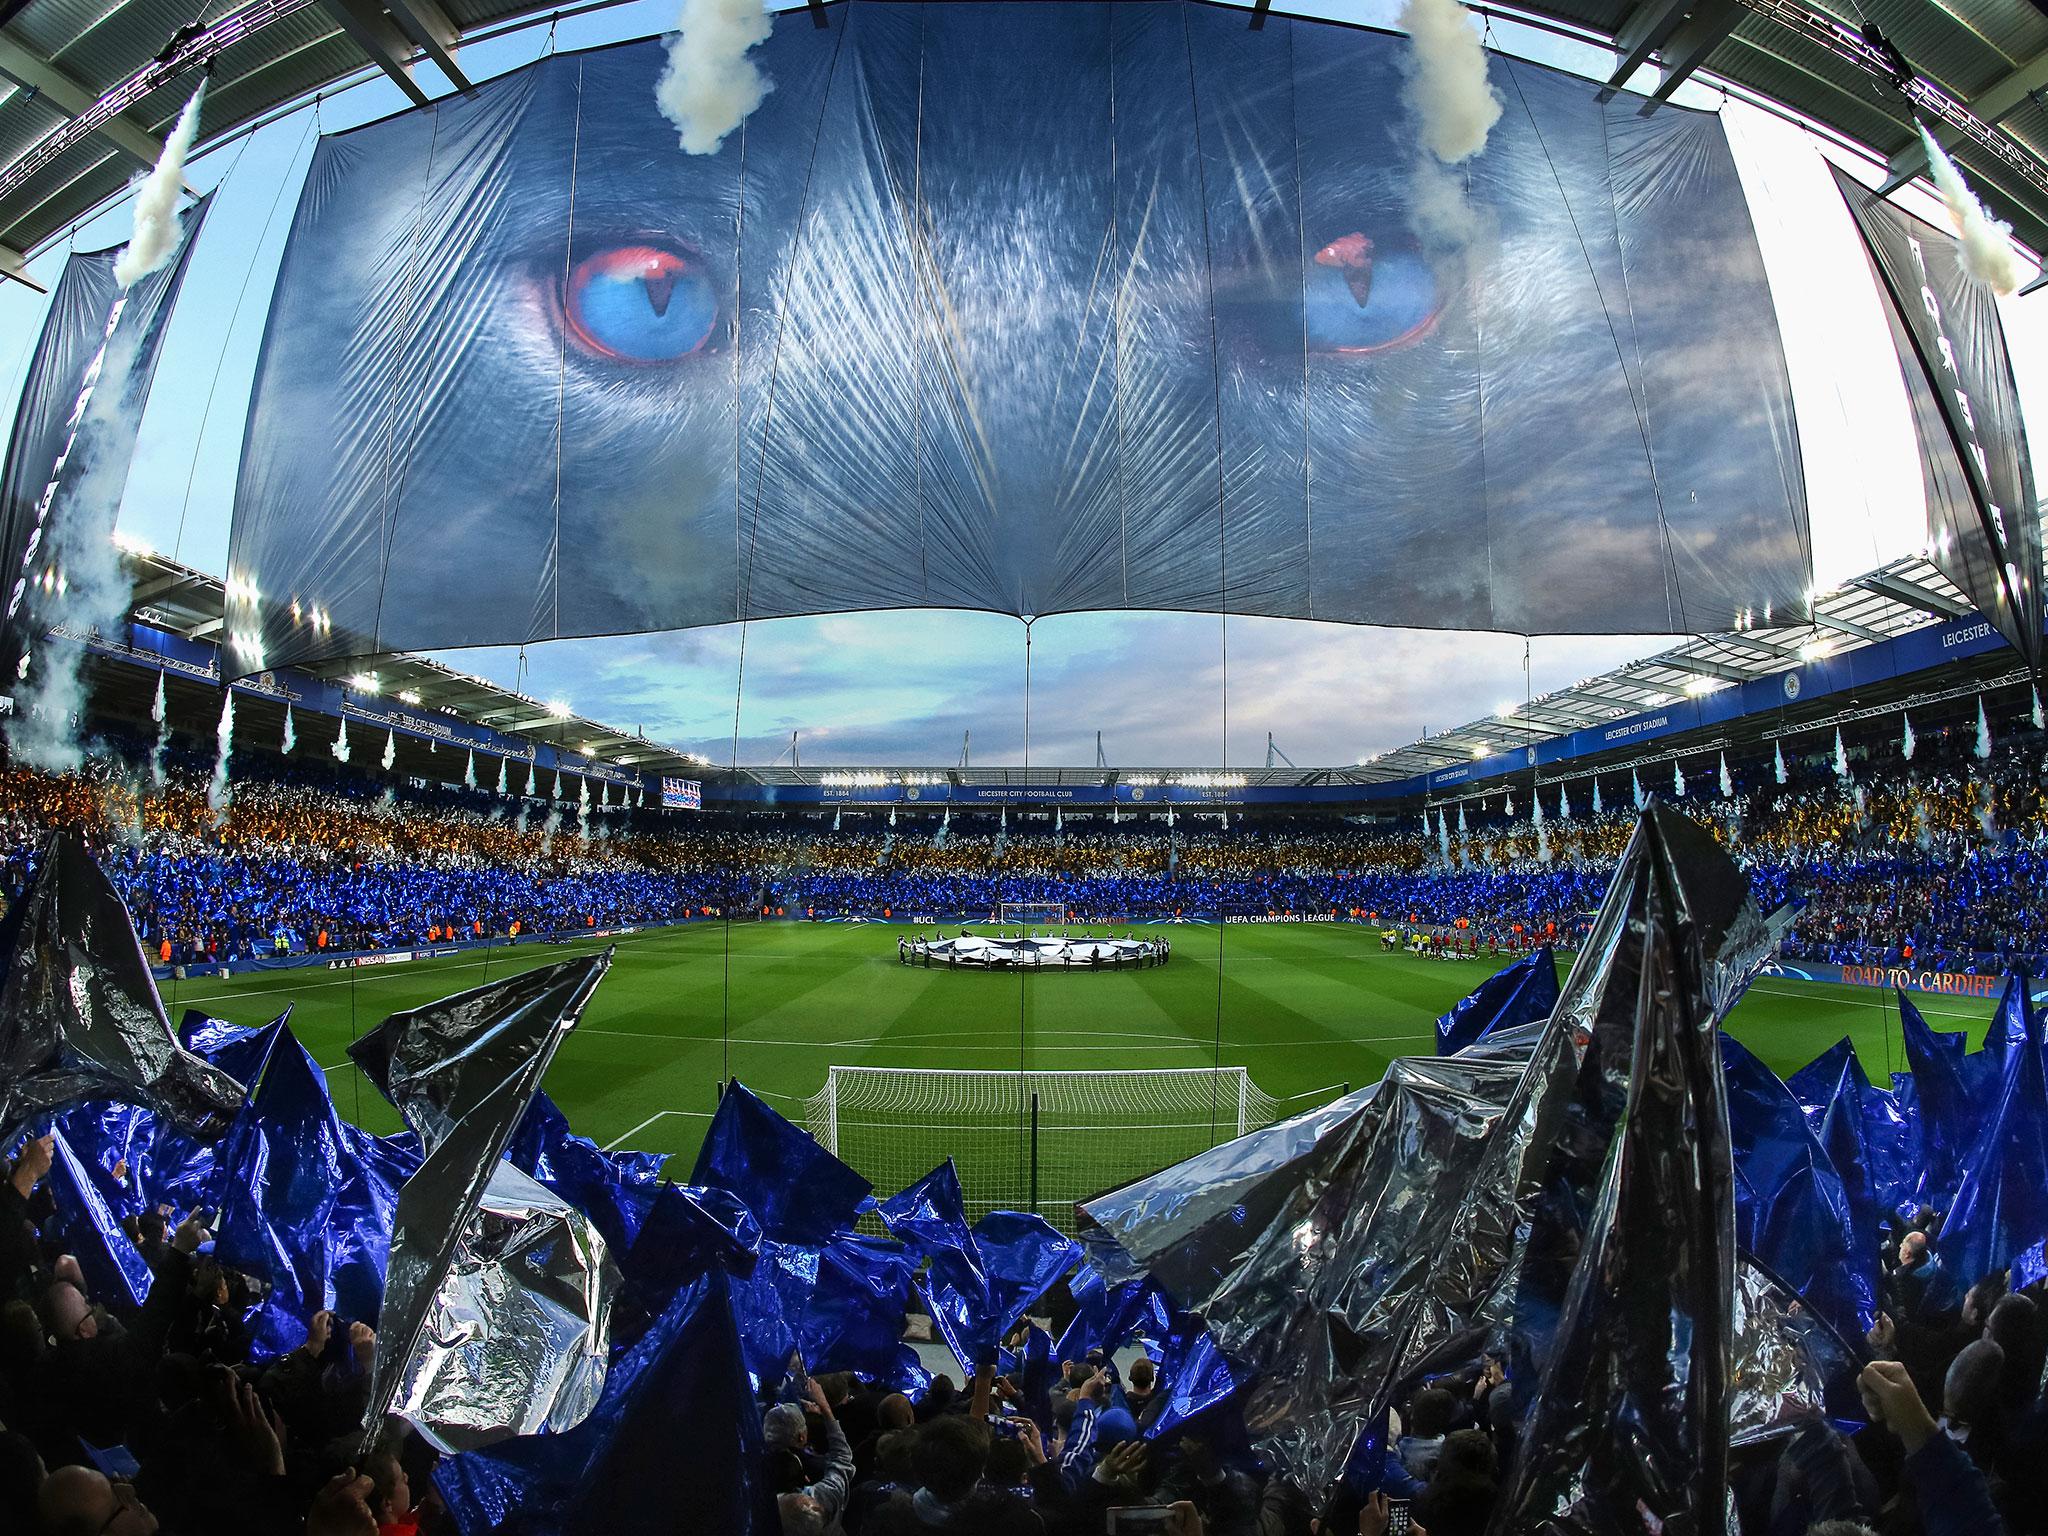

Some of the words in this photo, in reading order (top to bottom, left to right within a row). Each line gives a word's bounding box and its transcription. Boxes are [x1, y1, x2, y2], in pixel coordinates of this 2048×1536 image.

[1942, 622, 1991, 648] LEICESTER
[1605, 726, 1630, 741] LEICESTER
[1630, 723, 1642, 734] CITY
[1642, 716, 1668, 731] STADIUM
[978, 790, 1008, 798] LEICESTER
[1009, 790, 1023, 798] CITY
[1024, 790, 1056, 798] FOOTBALL
[1056, 790, 1073, 798] CLUB
[913, 916, 936, 925] #UCL
[1072, 917, 1085, 925] TO
[1089, 917, 1129, 925] CARDIFF
[1225, 915, 1249, 924] UEFA
[1250, 914, 1300, 923] CHAMPIONS
[1303, 912, 1336, 922] LEAGUE
[358, 953, 385, 967] NISSAN
[1841, 964, 1885, 987] ROAD
[1887, 967, 1910, 989] TO
[1919, 971, 1997, 998] CARDIFF
